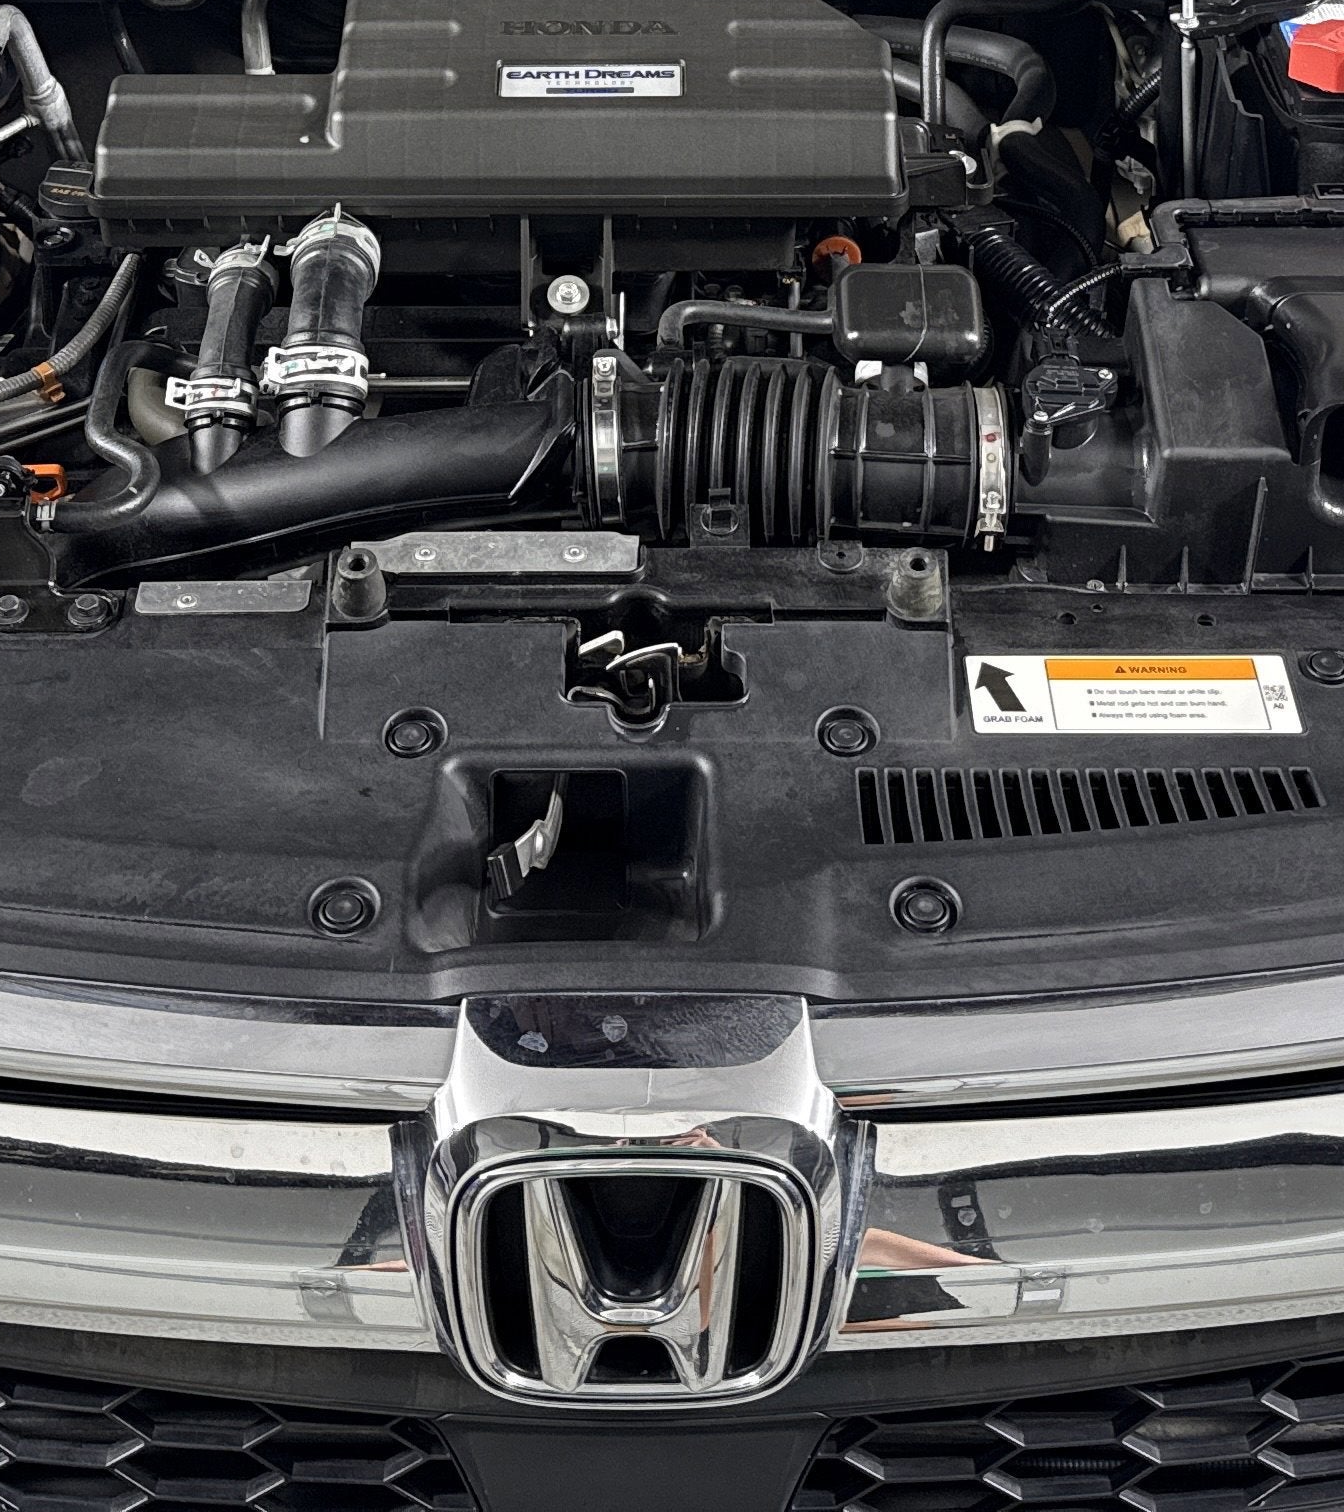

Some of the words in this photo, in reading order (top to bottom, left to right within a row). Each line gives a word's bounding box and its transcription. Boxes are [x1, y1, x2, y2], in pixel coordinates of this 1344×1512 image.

[500, 20, 680, 36] HONDA
[506, 70, 579, 80] EARTH
[584, 69, 675, 80] DREAMS
[1128, 666, 1187, 674] WARNING
[983, 715, 1012, 723] GRAB
[1014, 715, 1043, 723] FOAM
